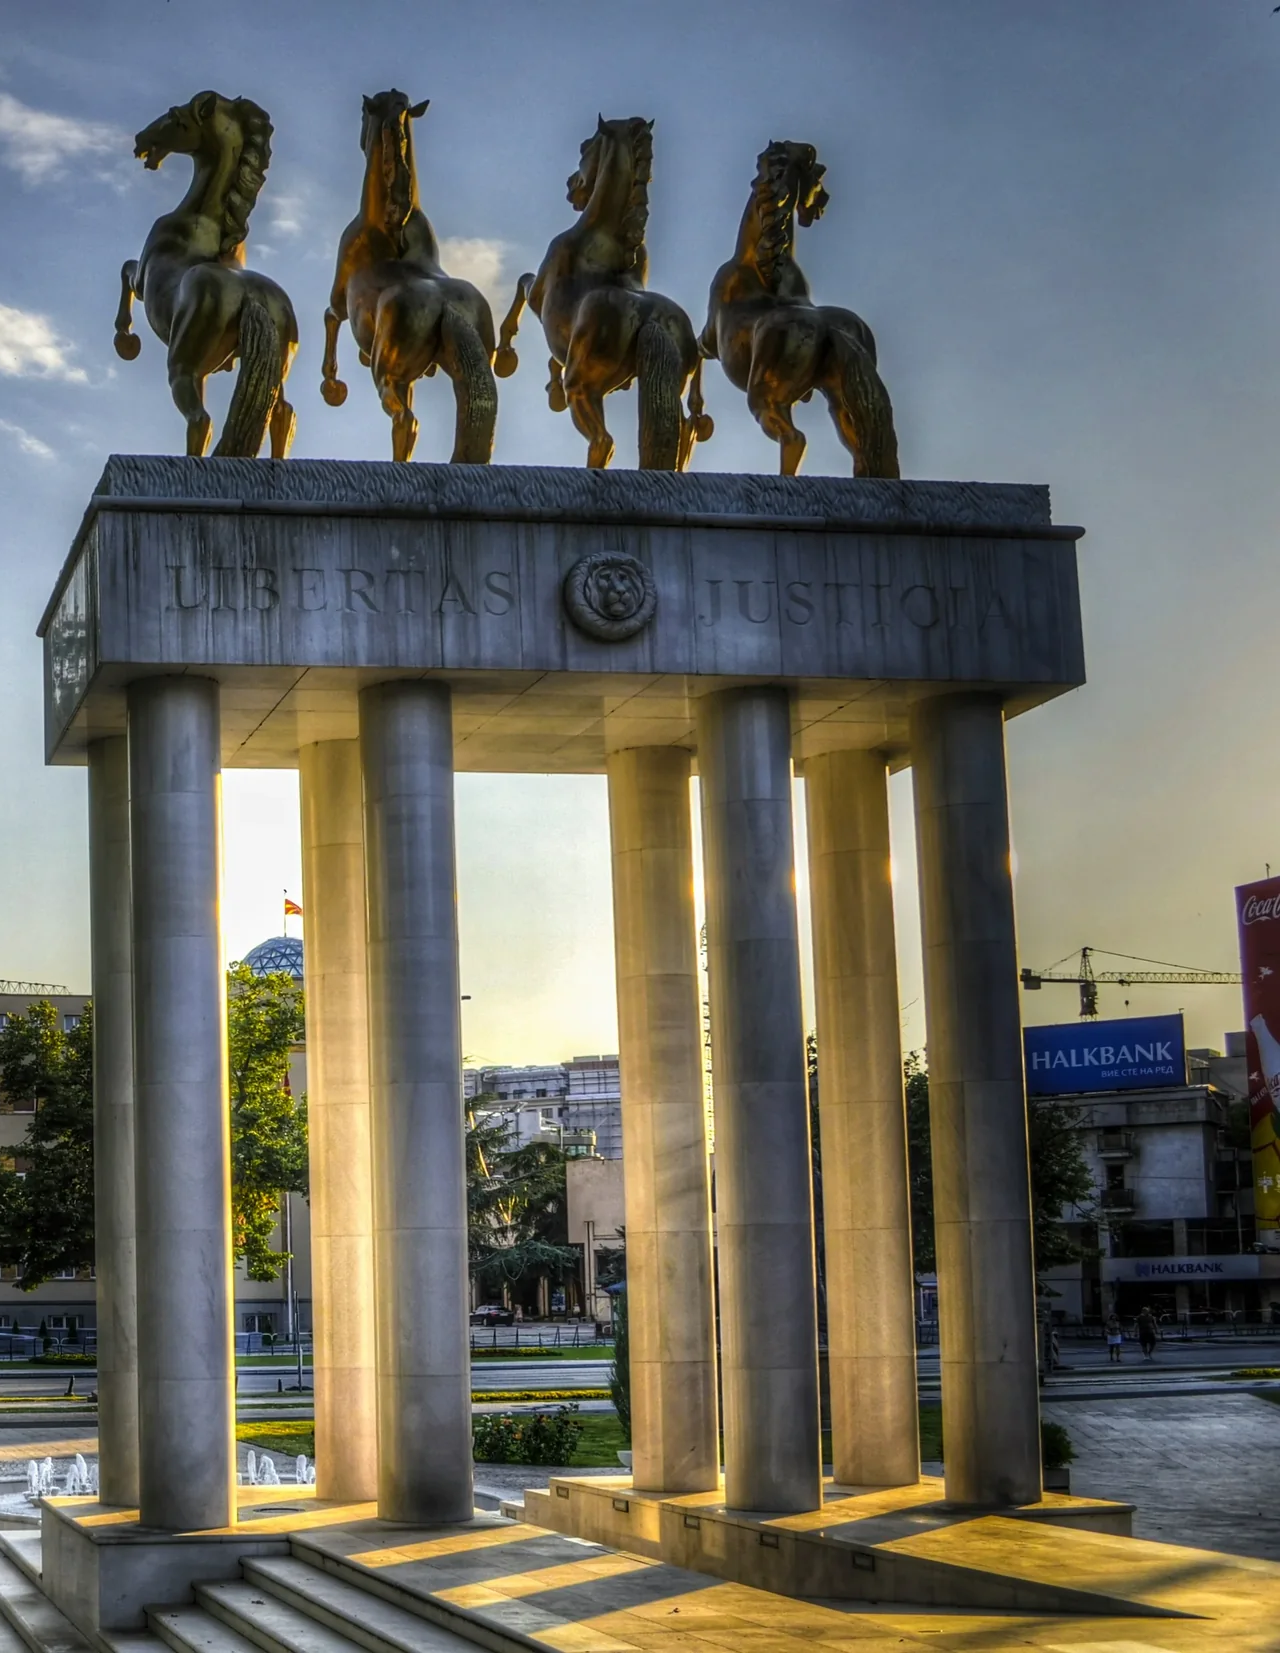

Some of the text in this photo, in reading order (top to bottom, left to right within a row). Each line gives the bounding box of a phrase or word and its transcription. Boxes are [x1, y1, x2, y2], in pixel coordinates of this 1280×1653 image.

[164, 564, 516, 616] LIBERTAS
[1242, 893, 1280, 925] Coca-C
[1032, 1041, 1174, 1070] HALKBANK
[1101, 1065, 1174, 1078] ВИЕ СТЕ НА РЕД
[1151, 1262, 1224, 1274] HALKBANK
